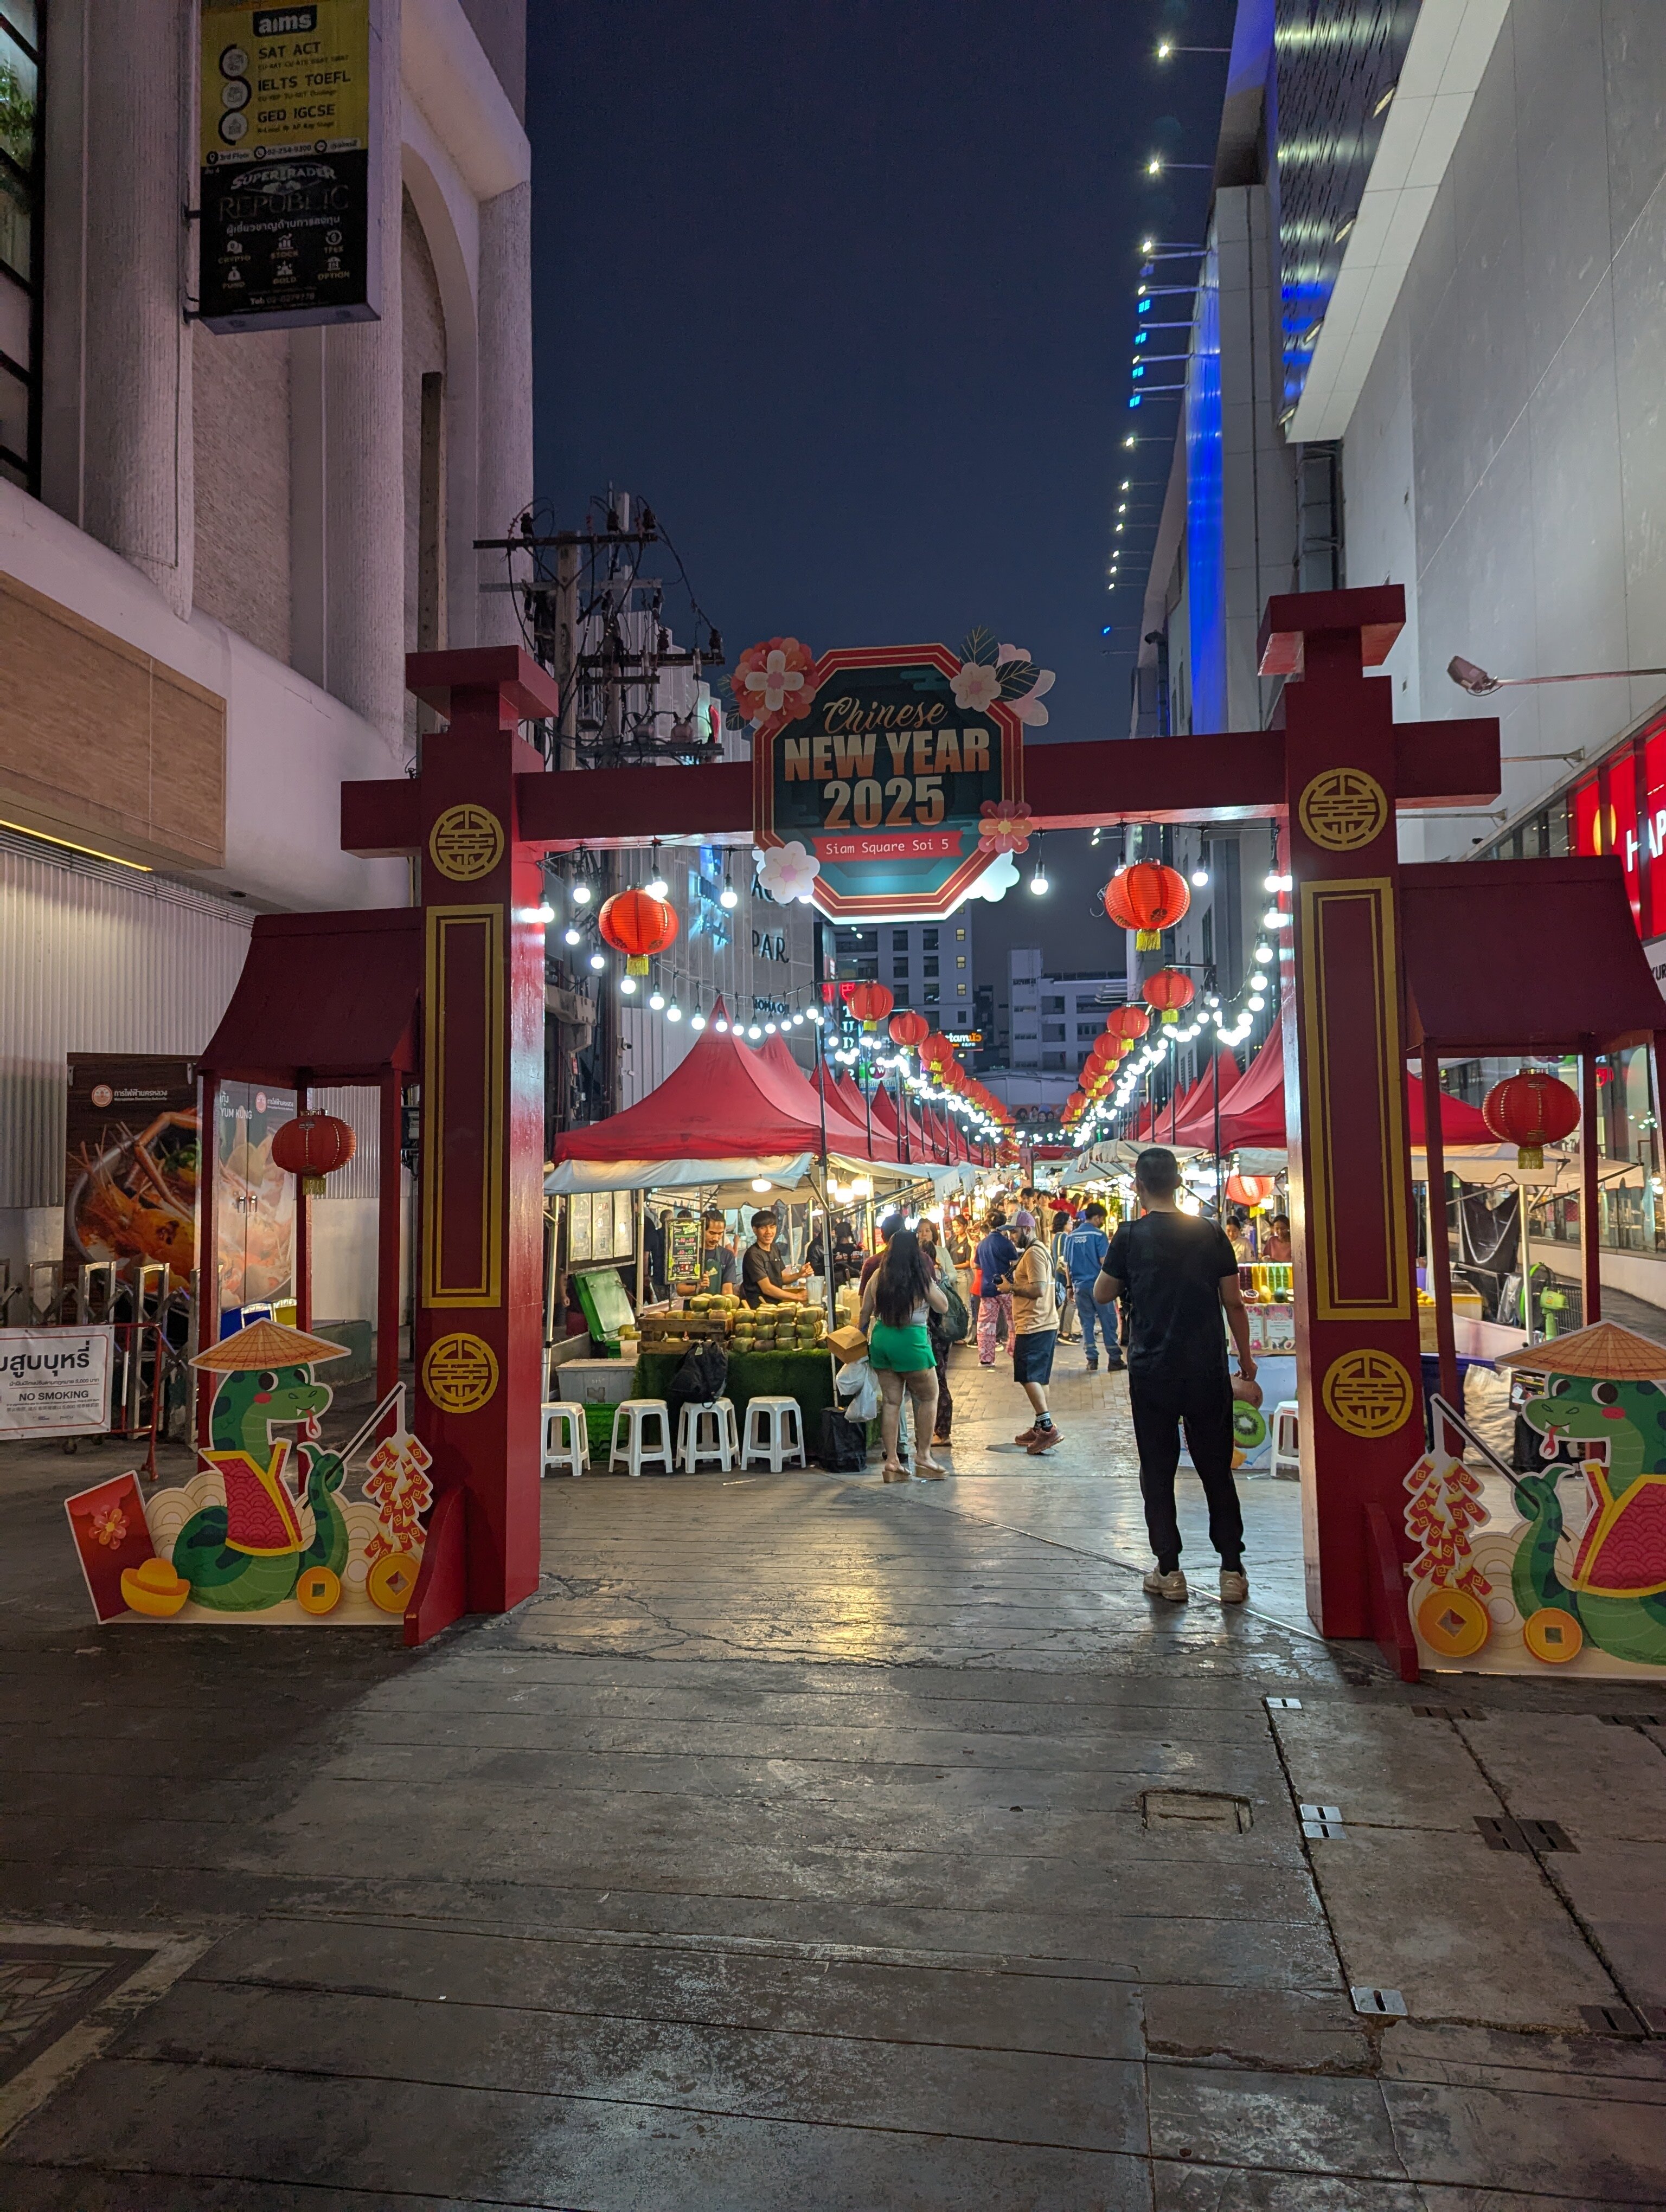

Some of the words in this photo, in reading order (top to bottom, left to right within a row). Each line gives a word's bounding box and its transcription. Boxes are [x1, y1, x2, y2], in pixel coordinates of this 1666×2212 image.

[259, 14, 312, 34] aims
[259, 46, 286, 60] SAT
[293, 42, 321, 55] ACT
[258, 76, 297, 91] IELTS
[305, 70, 351, 86] TOEFL
[258, 109, 286, 123] GED
[294, 104, 336, 119] IGCSE
[219, 184, 349, 222] REPUBLIC
[823, 697, 947, 734] Chinese
[784, 734, 876, 781] NEW
[886, 728, 990, 775] YEAR
[823, 776, 945, 829] 2025
[826, 843, 855, 855] Siam
[861, 841, 905, 854] Square
[912, 839, 935, 851] Soi
[941, 838, 949, 850] 5
[235, 1109, 252, 1120] KUNG
[19, 1393, 35, 1401] NO
[38, 1390, 89, 1400] SMOKING
